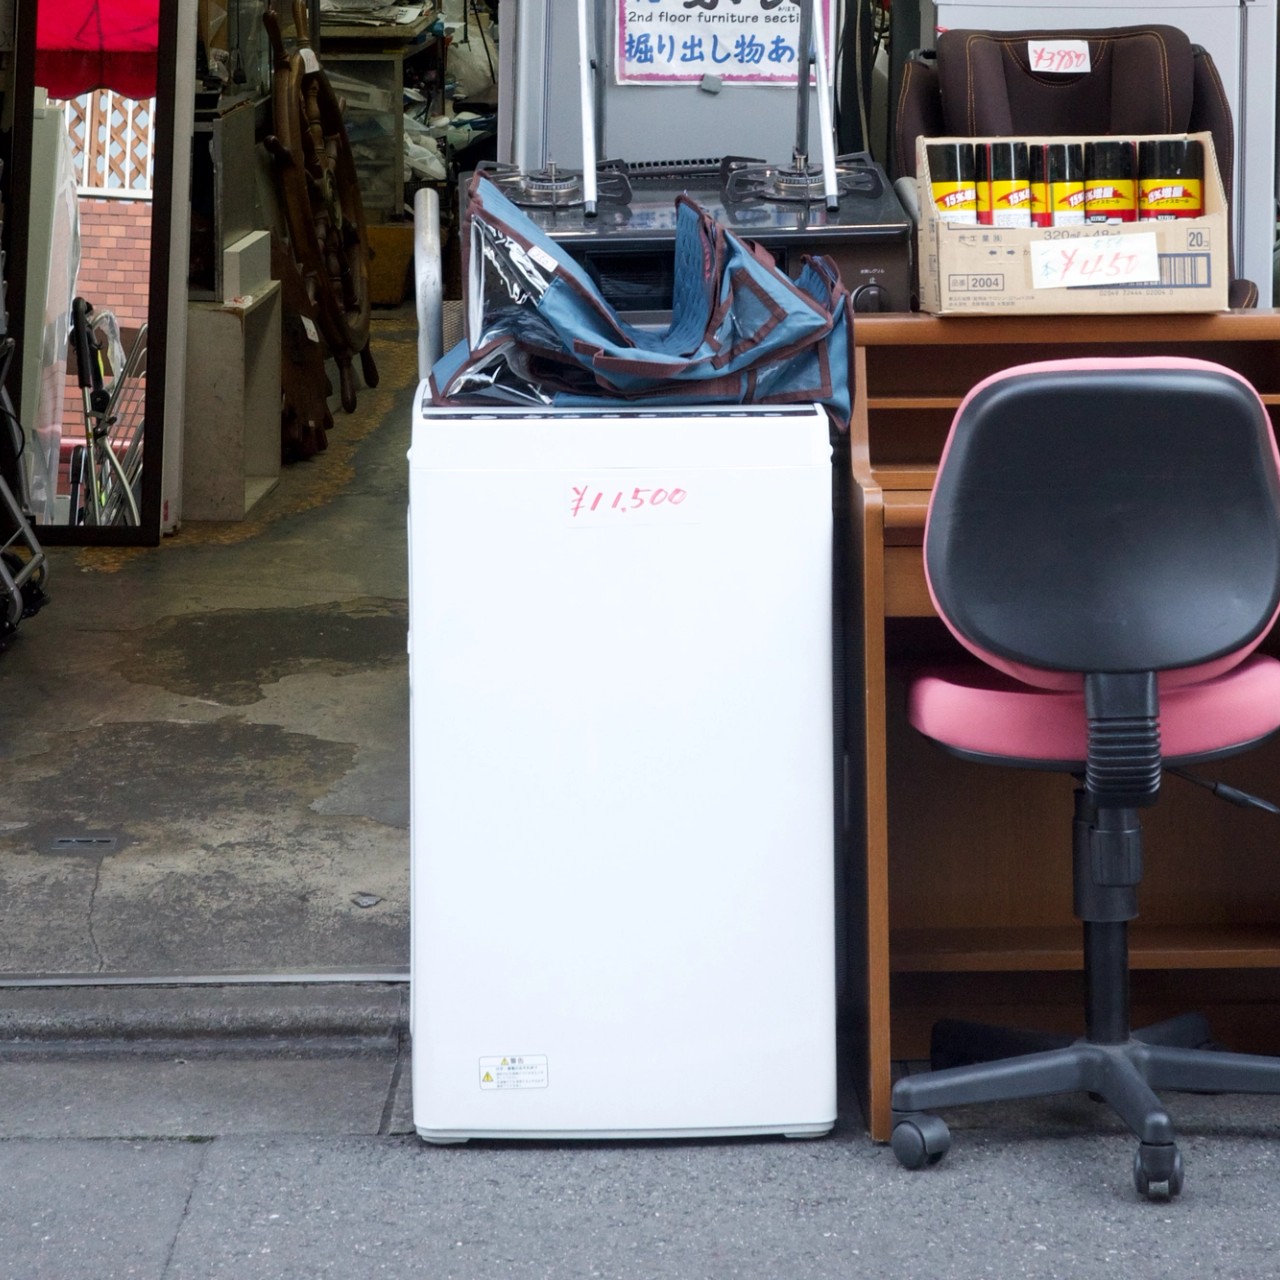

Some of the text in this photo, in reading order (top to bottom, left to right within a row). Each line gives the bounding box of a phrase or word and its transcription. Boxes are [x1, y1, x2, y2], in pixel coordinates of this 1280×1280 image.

[628, 11, 653, 23] 2nd
[659, 11, 692, 23] floor
[697, 12, 759, 23] furniture
[626, 32, 796, 64] 掘り出し物あ
[1060, 248, 1139, 281] ¥450
[971, 276, 1000, 288] 2004
[570, 484, 688, 517] ¥11,500
